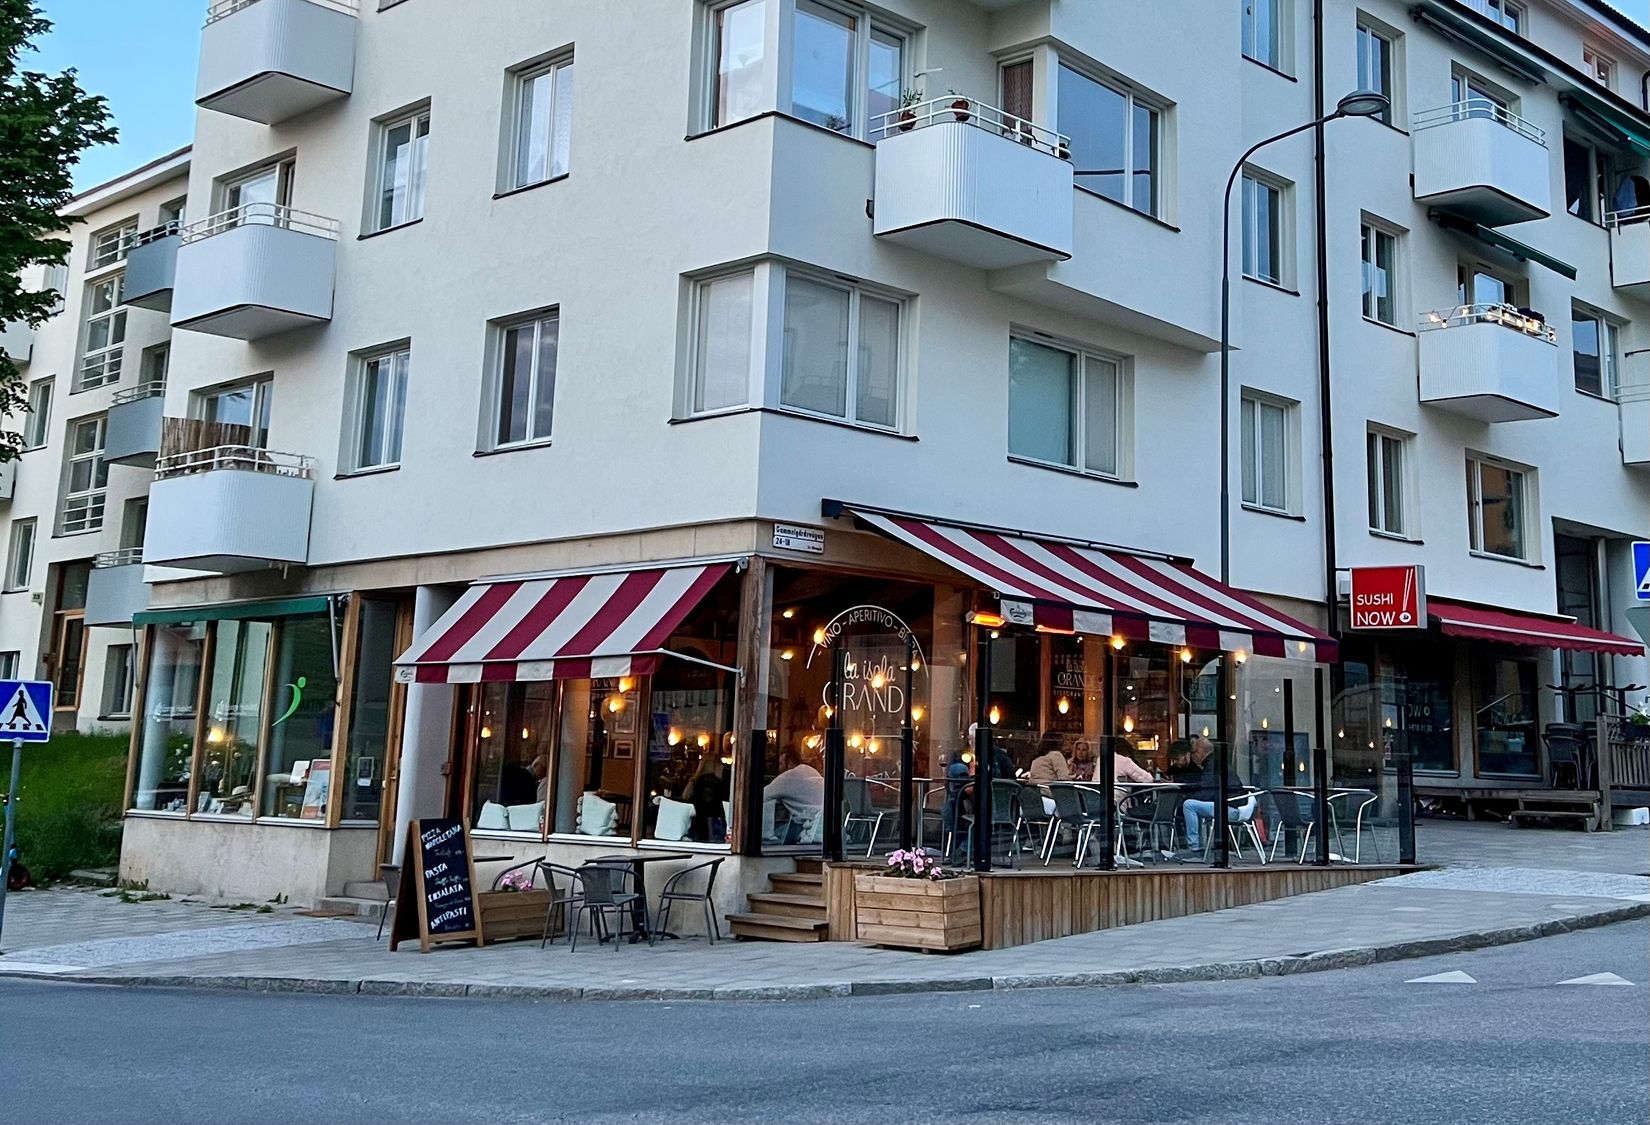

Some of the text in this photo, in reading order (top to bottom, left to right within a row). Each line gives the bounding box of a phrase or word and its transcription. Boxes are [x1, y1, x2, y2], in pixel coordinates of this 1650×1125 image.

[1356, 592, 1394, 606] SUSHI
[820, 622, 842, 649] VINO
[848, 609, 893, 628] APERITIVO
[421, 827, 441, 843] PIZZA
[425, 862, 448, 879] PASTA
[428, 883, 464, 903] INSALATA
[430, 906, 467, 930] ANTIPASTI
